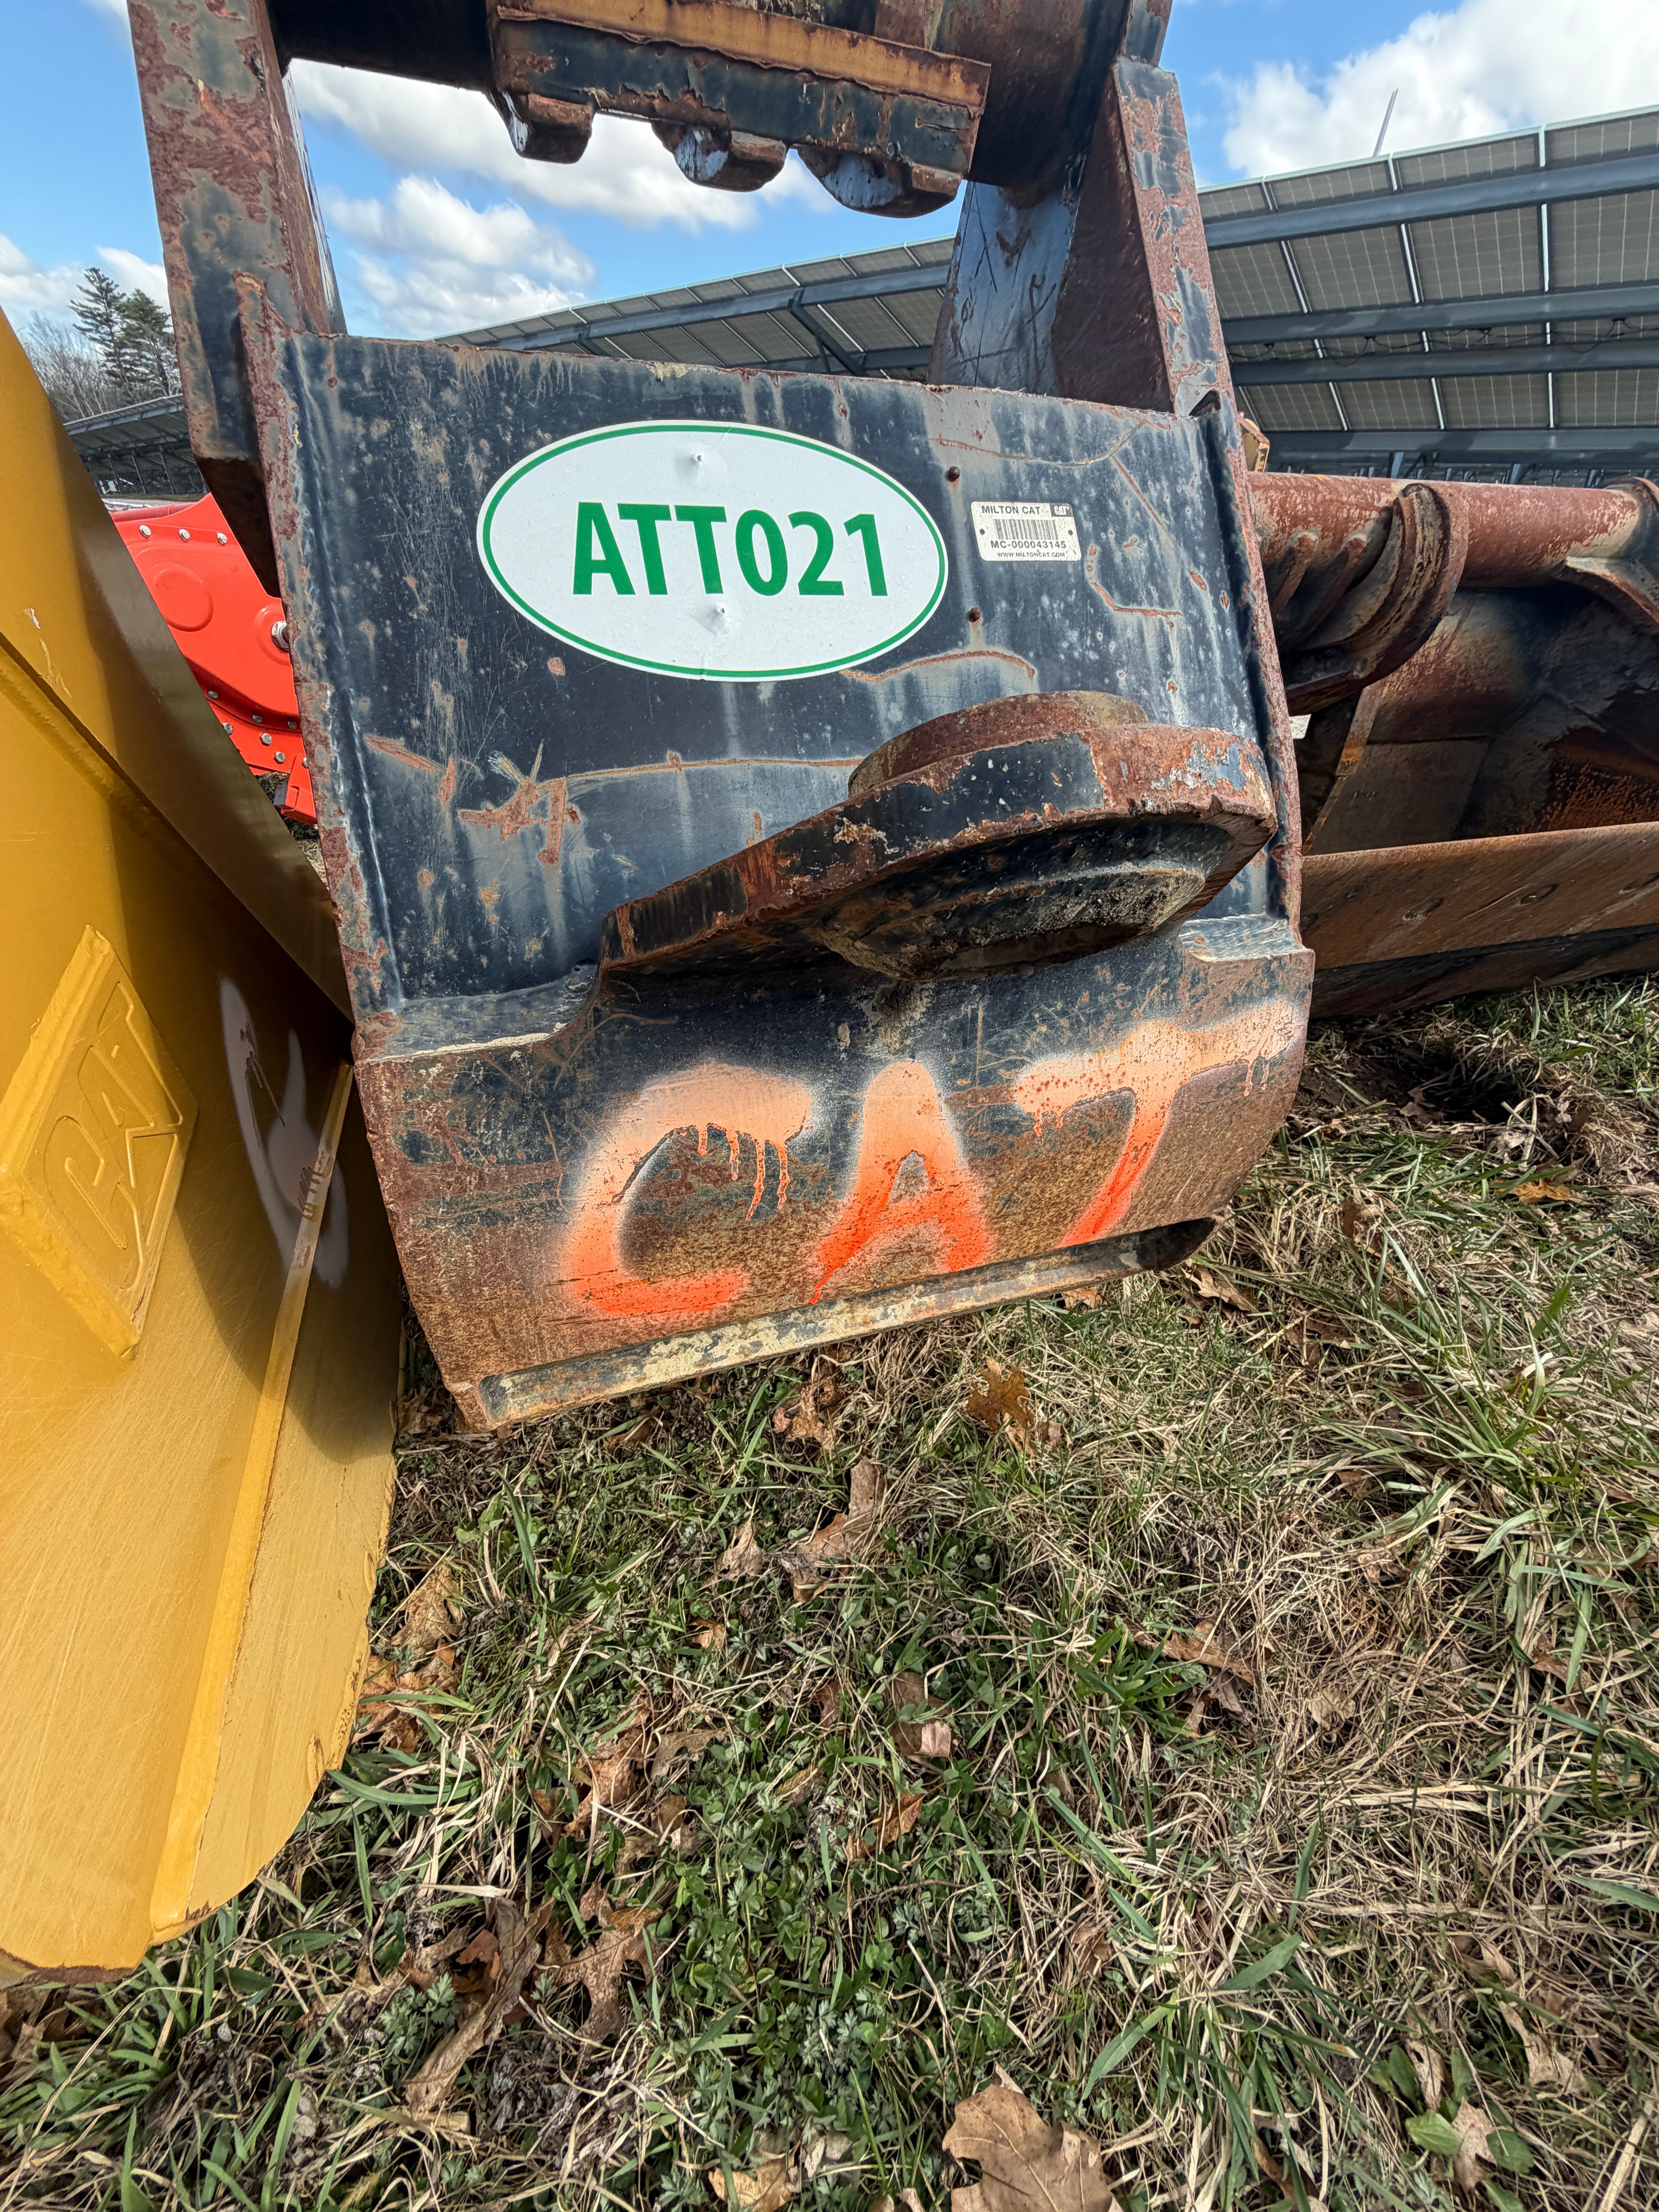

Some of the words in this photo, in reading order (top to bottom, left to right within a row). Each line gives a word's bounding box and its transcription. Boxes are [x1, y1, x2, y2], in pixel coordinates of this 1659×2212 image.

[981, 505, 1019, 514] MILTON
[1022, 507, 1041, 515] CAT
[572, 501, 888, 597] ATT021
[990, 540, 1066, 549] MC-000043145
[560, 1003, 1304, 1316] CAT
